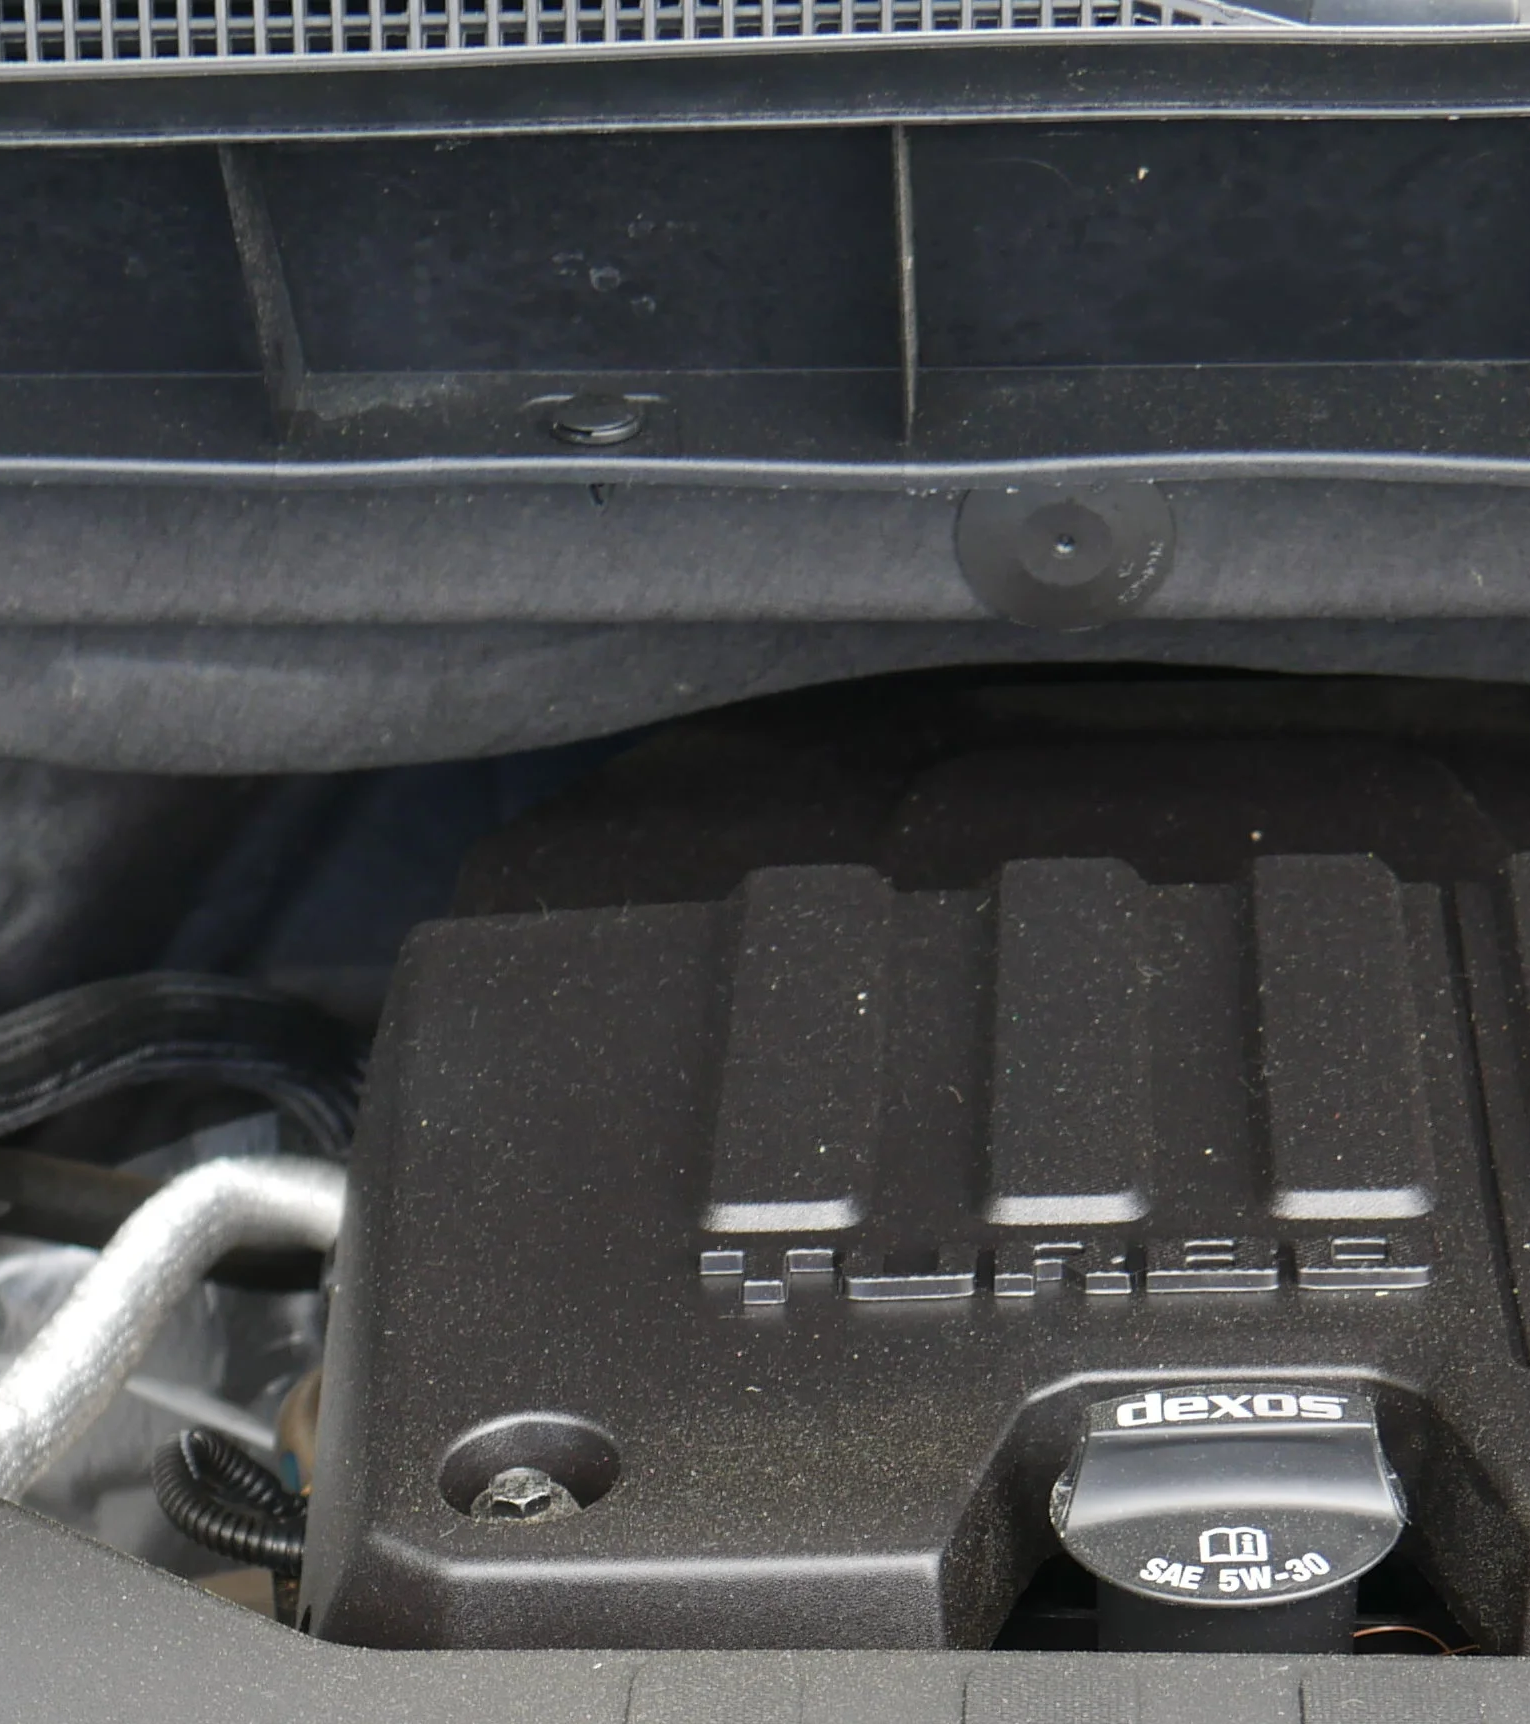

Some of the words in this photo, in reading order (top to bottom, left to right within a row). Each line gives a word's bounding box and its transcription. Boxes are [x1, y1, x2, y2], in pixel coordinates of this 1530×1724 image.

[699, 1231, 1431, 1305] TURBO
[1117, 1393, 1344, 1427] dexos
[1140, 1557, 1205, 1590] SAE
[1218, 1552, 1331, 1593] 5W-30
